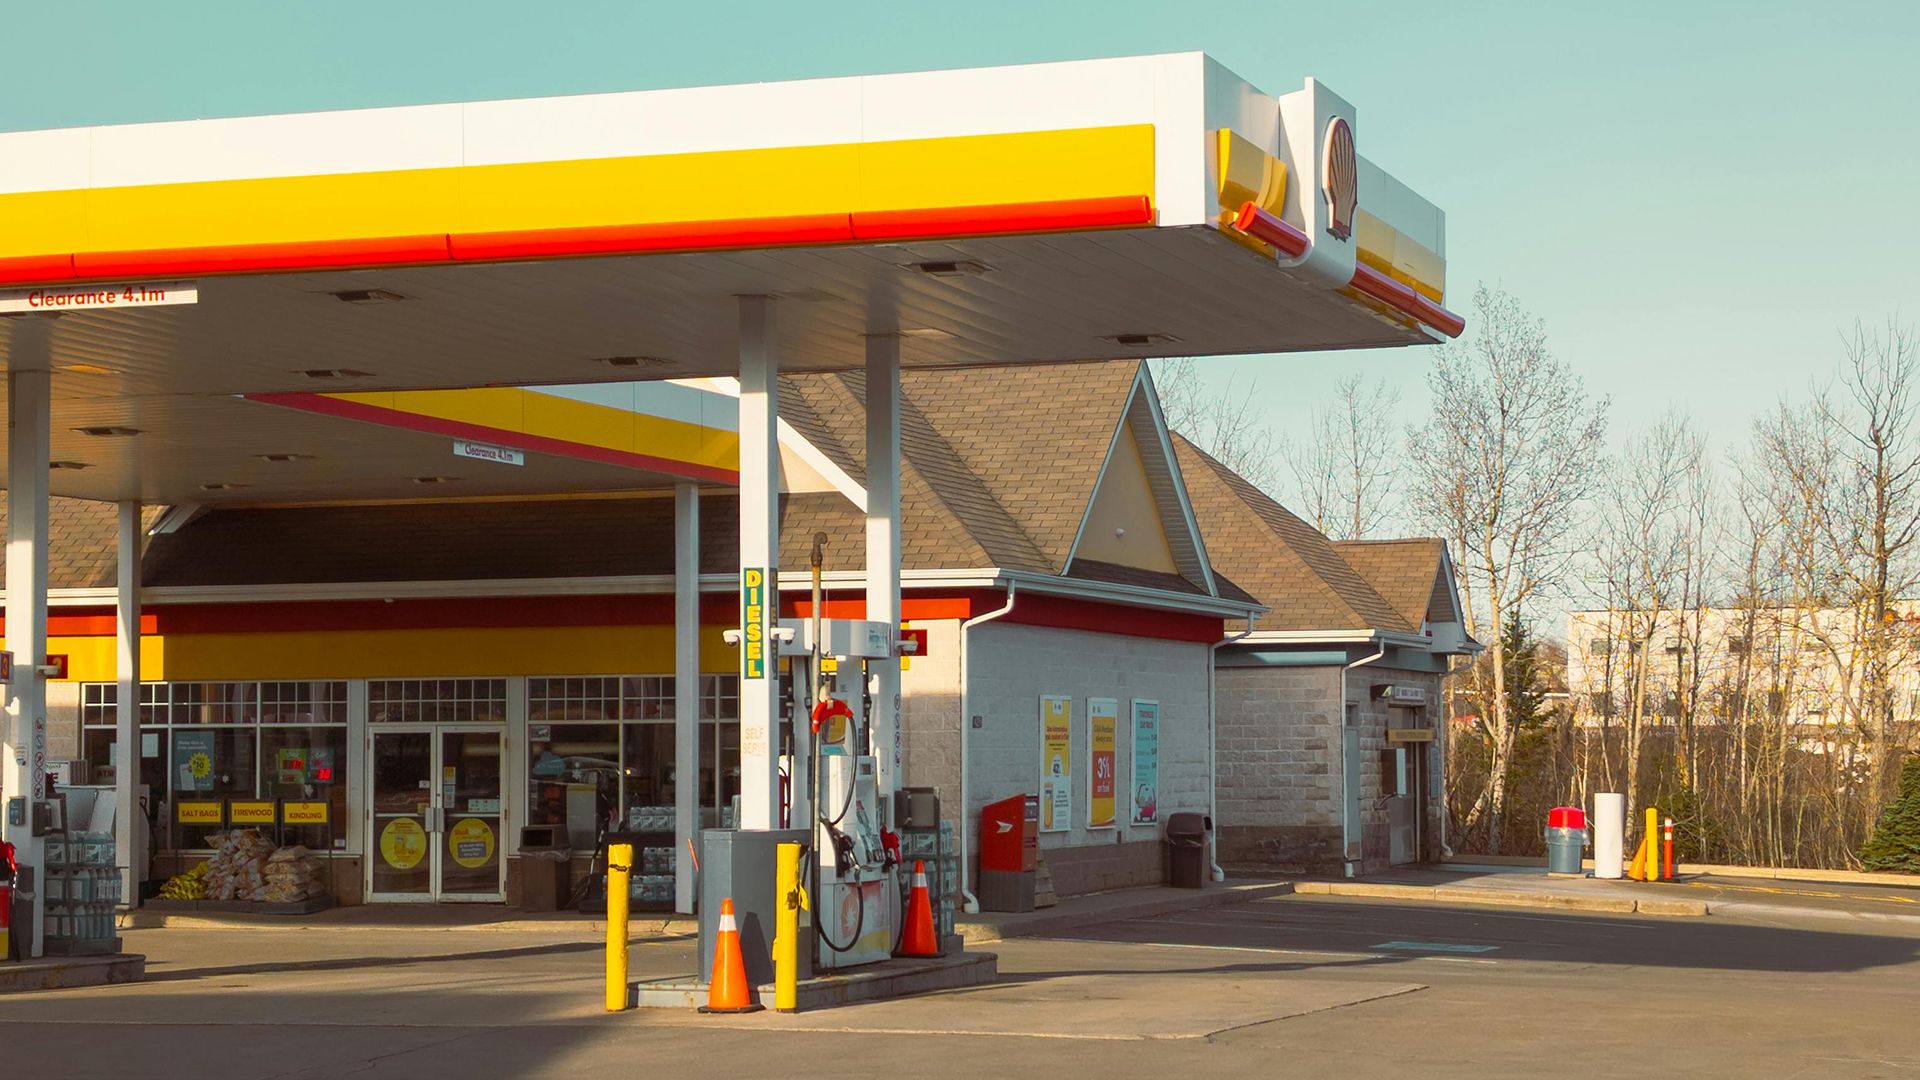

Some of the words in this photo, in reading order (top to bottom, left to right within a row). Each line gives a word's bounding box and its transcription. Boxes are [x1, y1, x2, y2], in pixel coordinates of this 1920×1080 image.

[28, 289, 116, 308] Clearance
[122, 286, 165, 303] 4.1m
[464, 443, 497, 459] Clearance
[498, 449, 514, 462] 4.1m
[745, 569, 762, 677] DIESEL
[745, 727, 764, 739] SELF
[743, 742, 767, 754] SERVE
[1097, 756, 1111, 779] 3%
